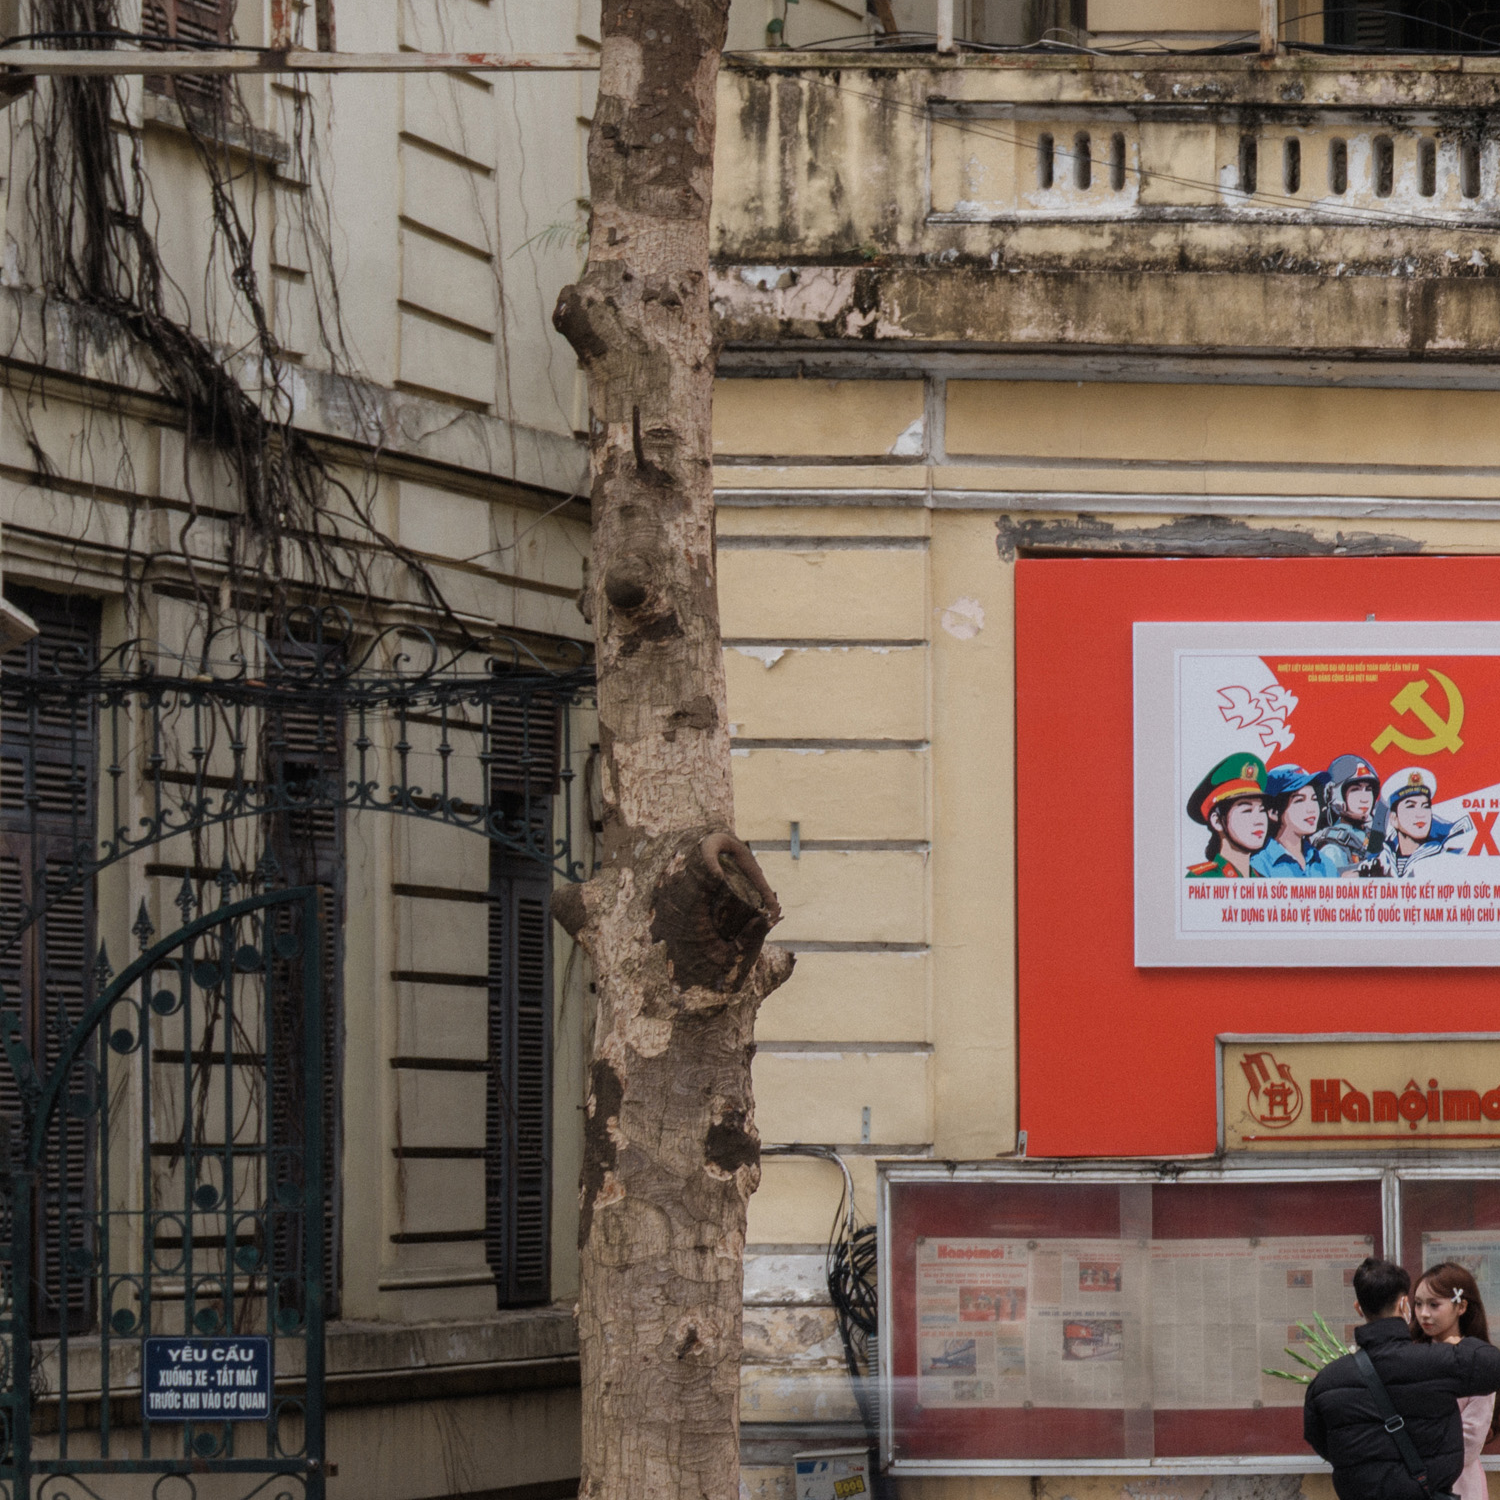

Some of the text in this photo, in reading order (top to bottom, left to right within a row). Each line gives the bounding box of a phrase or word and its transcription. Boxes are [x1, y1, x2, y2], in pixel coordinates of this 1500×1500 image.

[1462, 799, 1485, 812] ĐẠI
[1188, 882, 1210, 899] PHÁT
[1213, 885, 1230, 899] HUY
[1232, 882, 1237, 899] Ý
[1240, 882, 1254, 899] CHÍ
[1257, 882, 1268, 899] VÀ
[1271, 881, 1288, 899] SỨC
[1291, 885, 1316, 902] MẠNH
[1319, 885, 1333, 902] ĐẠI
[1336, 882, 1359, 899] ĐOÀN
[1362, 880, 1378, 899] KẾT
[1380, 883, 1398, 899] DÂN
[1401, 883, 1417, 902] TỘC
[1419, 880, 1435, 899] KẾT
[1437, 884, 1455, 902] HỢP
[1457, 881, 1471, 899] VỚI
[1474, 881, 1491, 899] SỨC
[1222, 905, 1238, 922] XÂY
[1241, 907, 1265, 925] DỰNG
[1267, 905, 1278, 922] VÀ
[1281, 903, 1298, 922] BẢO
[1300, 906, 1311, 925] VỆ
[1313, 905, 1337, 922] VỮNG
[1339, 904, 1362, 922] CHẮC
[1365, 903, 1376, 922] TỔ
[1377, 904, 1401, 923] QUỐC
[1403, 905, 1421, 925] VIỆT
[1423, 908, 1444, 922] NAM
[1446, 905, 1458, 922] XÃ
[1460, 905, 1475, 925] HỘI
[1477, 902, 1495, 922] CHỦ
[168, 1345, 208, 1362] YÊU
[159, 1364, 258, 1387] XUỐNG XE TẮT MÁY
[149, 1389, 266, 1411] TRƯỚC KHI VÀO CƠ QUAN
